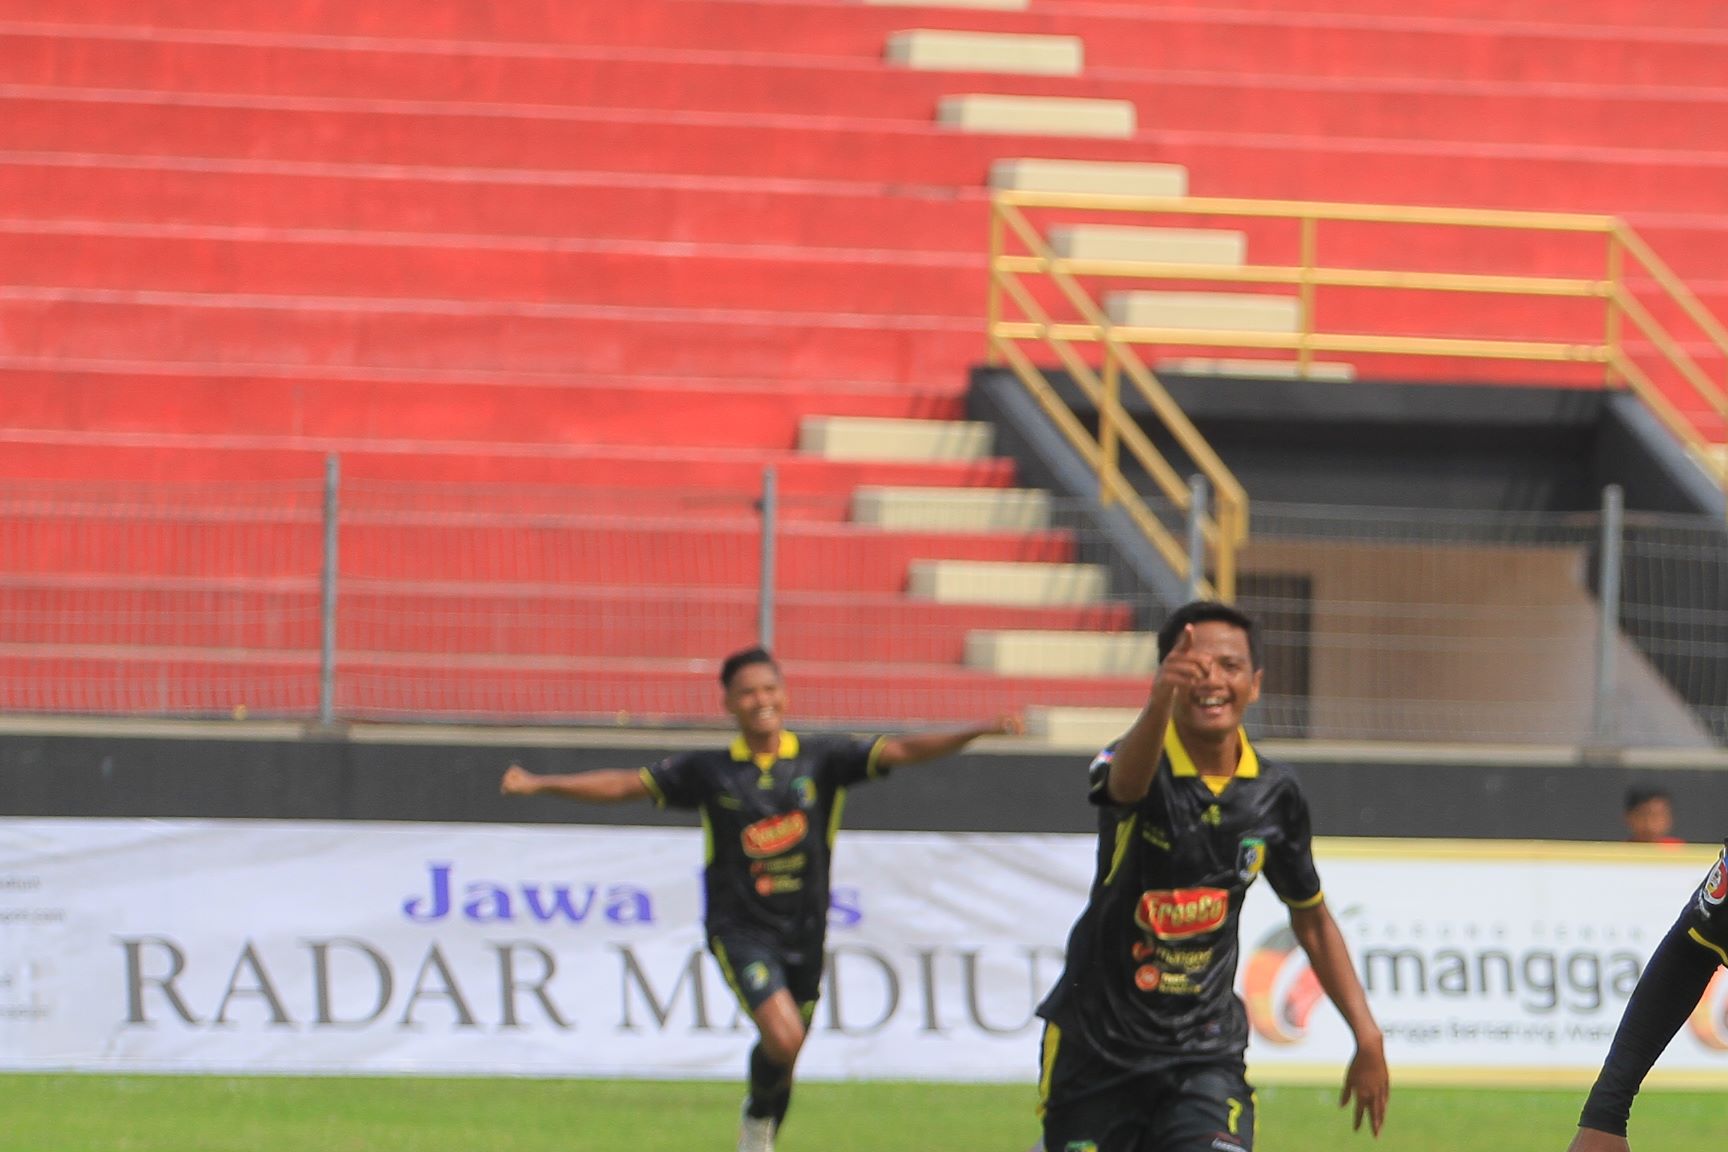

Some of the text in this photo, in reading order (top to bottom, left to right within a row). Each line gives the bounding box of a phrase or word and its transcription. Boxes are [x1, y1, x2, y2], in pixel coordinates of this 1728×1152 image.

[402, 860, 656, 924] Jawa
[112, 932, 1067, 1036] RADAR MDIU
[1361, 946, 1646, 1014] mangga
